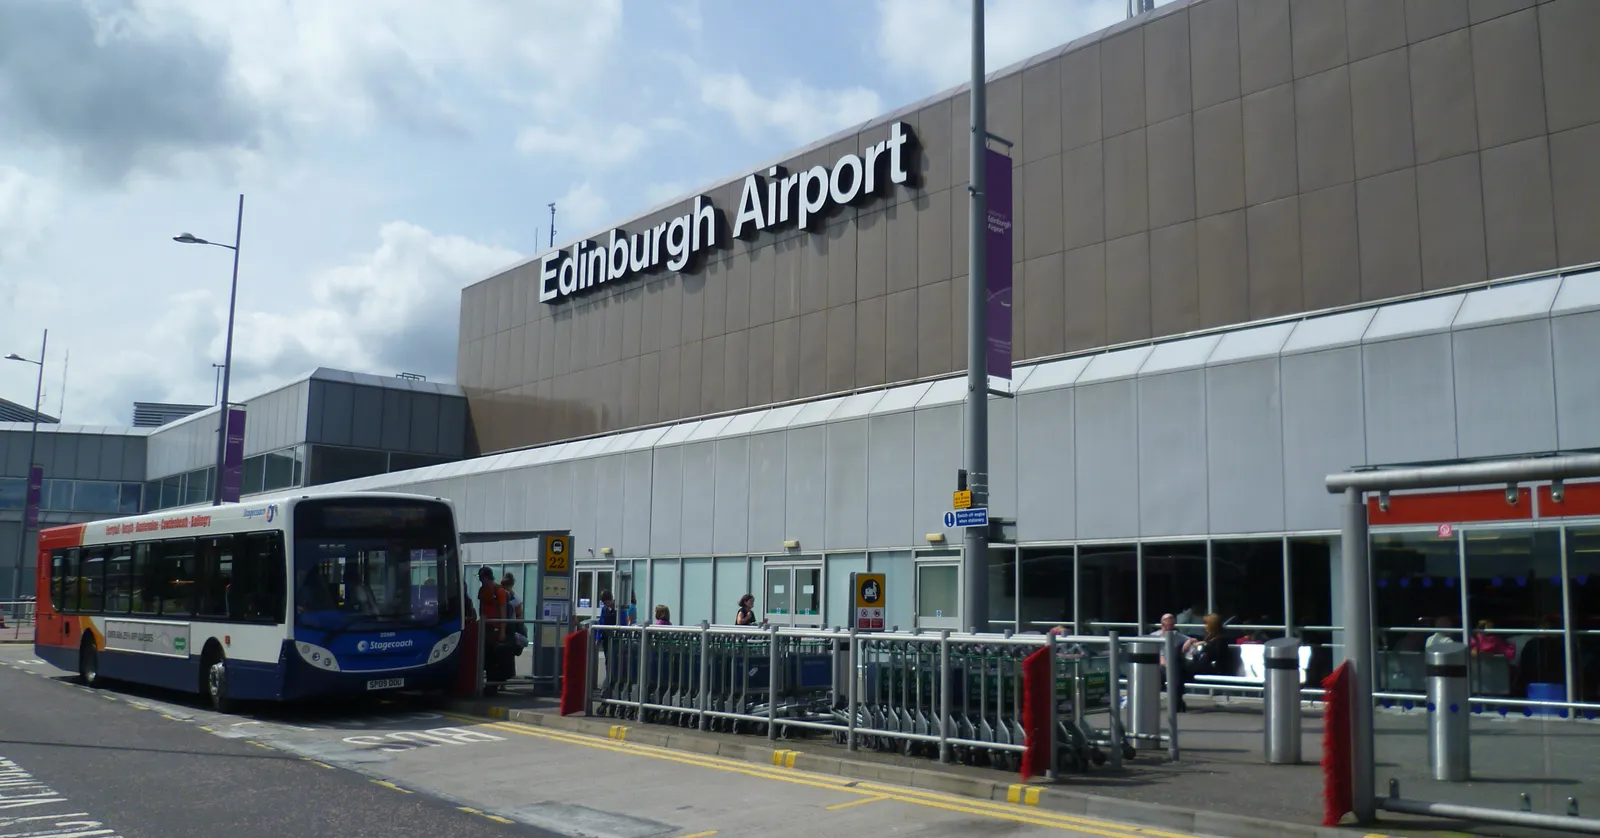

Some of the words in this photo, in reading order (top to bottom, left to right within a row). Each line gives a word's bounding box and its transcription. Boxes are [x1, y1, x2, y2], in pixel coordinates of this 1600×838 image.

[539, 193, 716, 304] Edinburgh
[732, 121, 908, 238] Airport
[987, 215, 1012, 230] Edinburgh
[987, 223, 1004, 234] Airport
[549, 556, 565, 569] 22
[370, 639, 413, 651] Stagecoach
[369, 680, 388, 688] SP09
[342, 727, 508, 752] BUS
